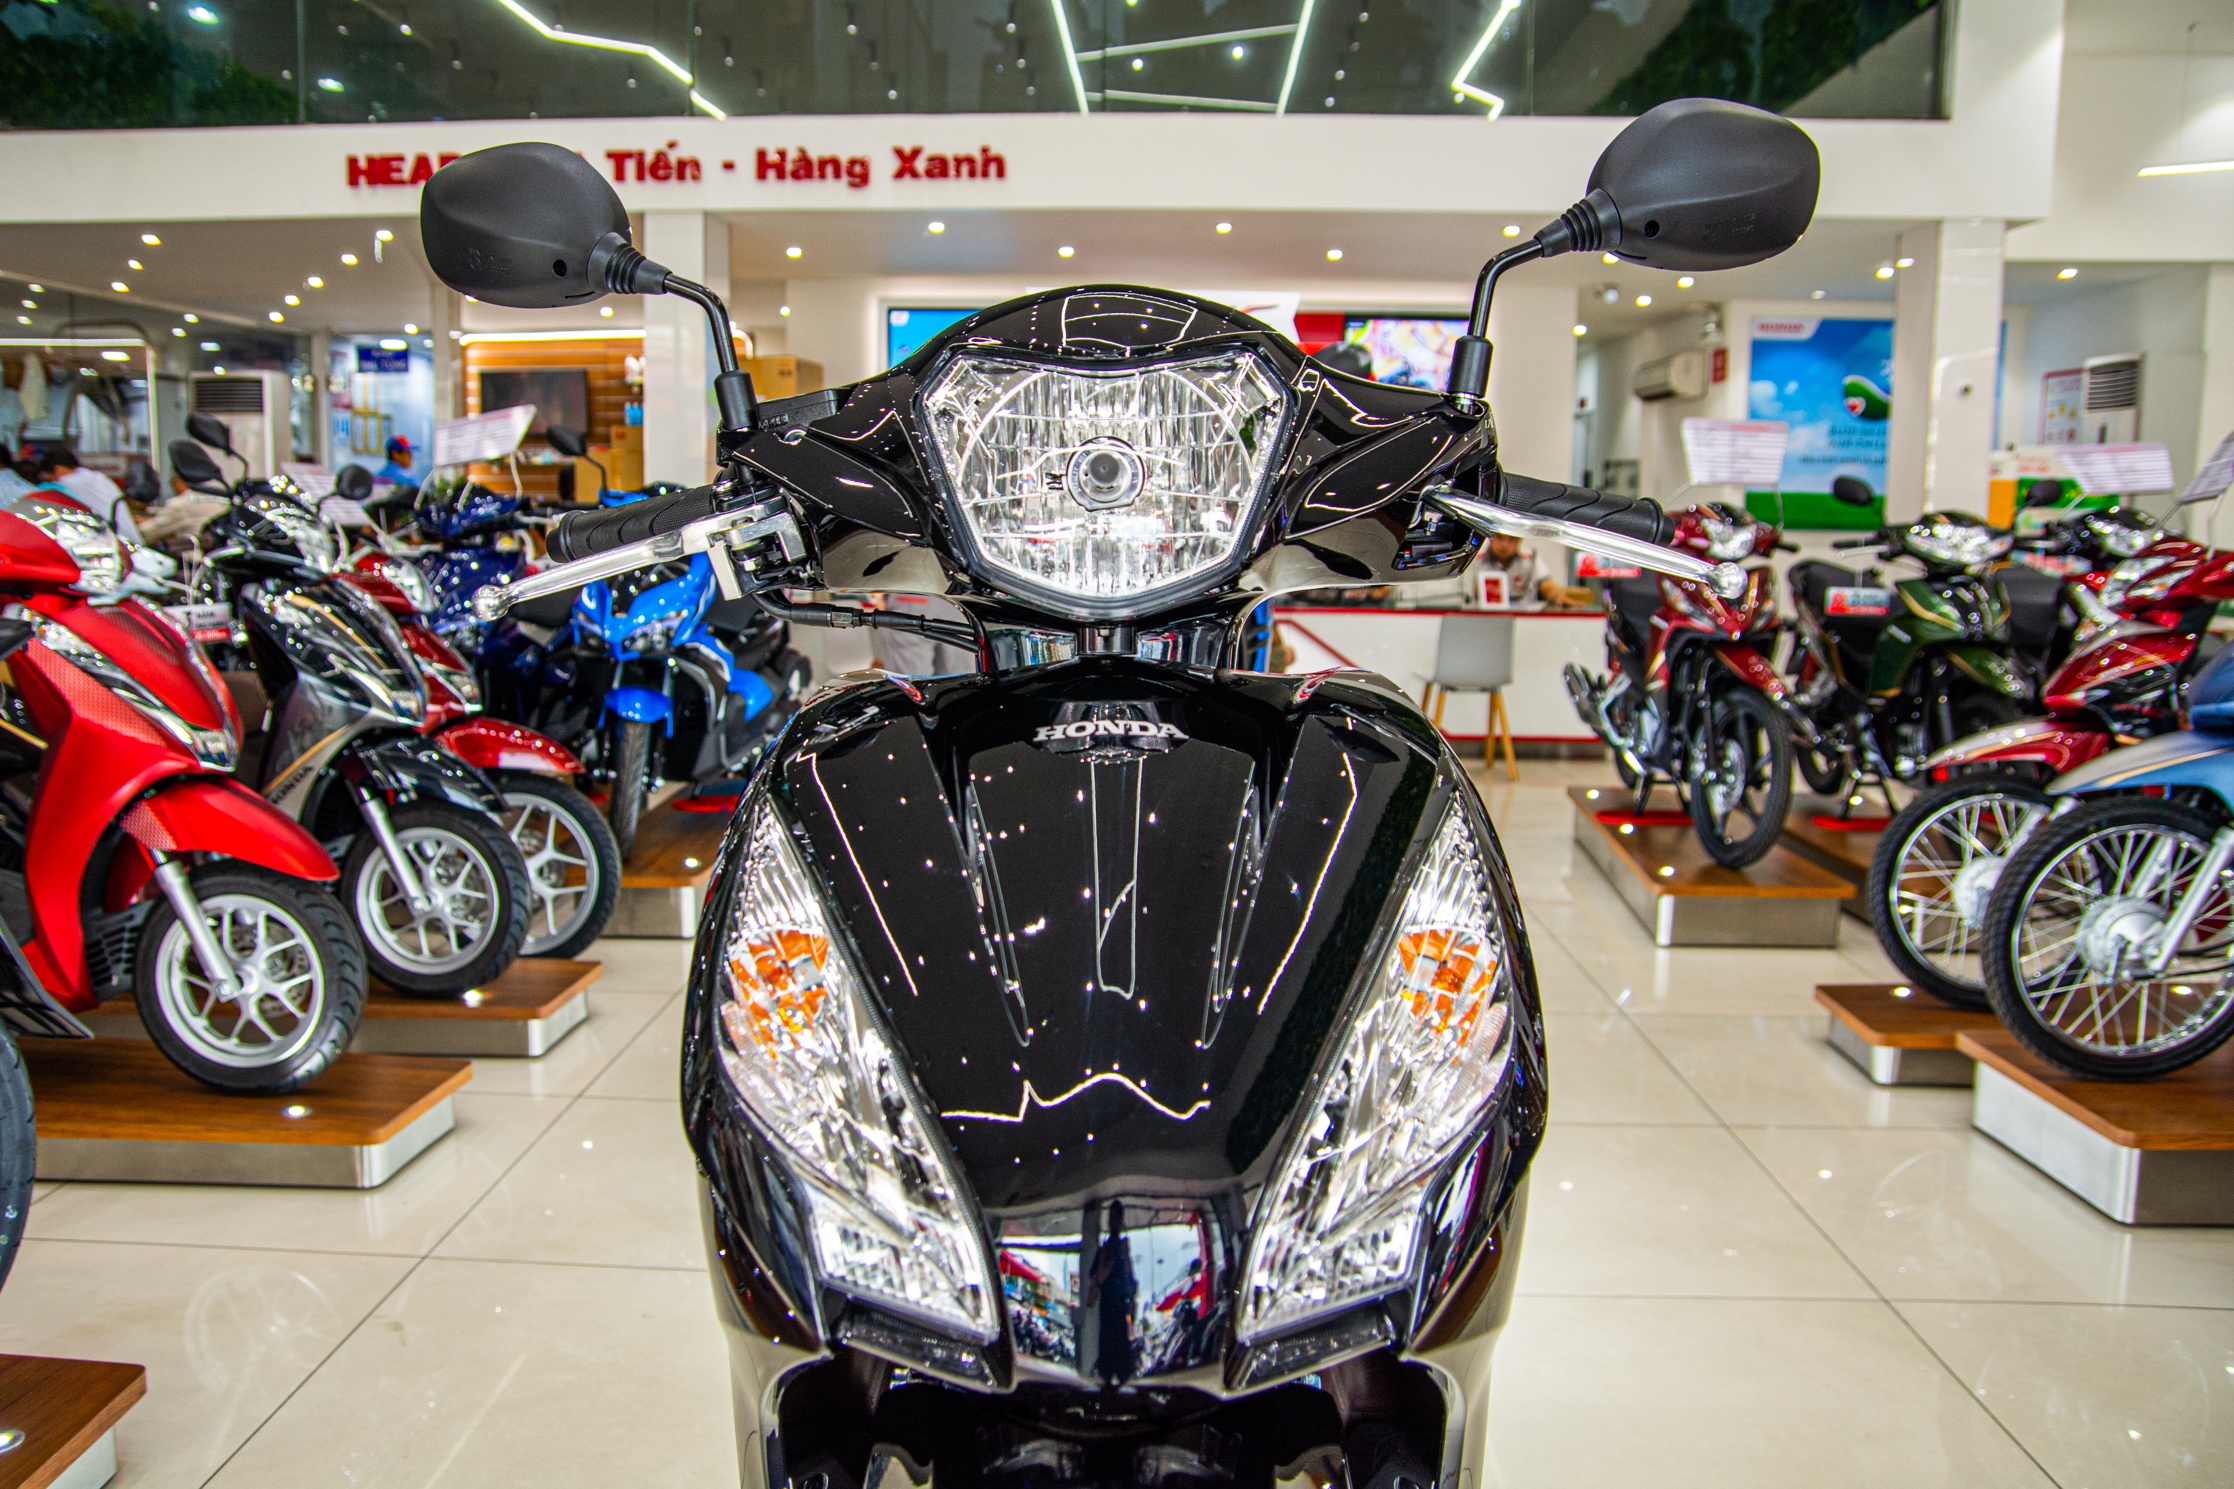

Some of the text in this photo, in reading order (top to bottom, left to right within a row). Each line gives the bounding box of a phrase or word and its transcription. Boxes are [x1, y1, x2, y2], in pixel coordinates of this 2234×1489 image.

[346, 140, 1007, 188] HEA Tiến - Hàng Xanh
[1033, 720, 1190, 742] HONDA
